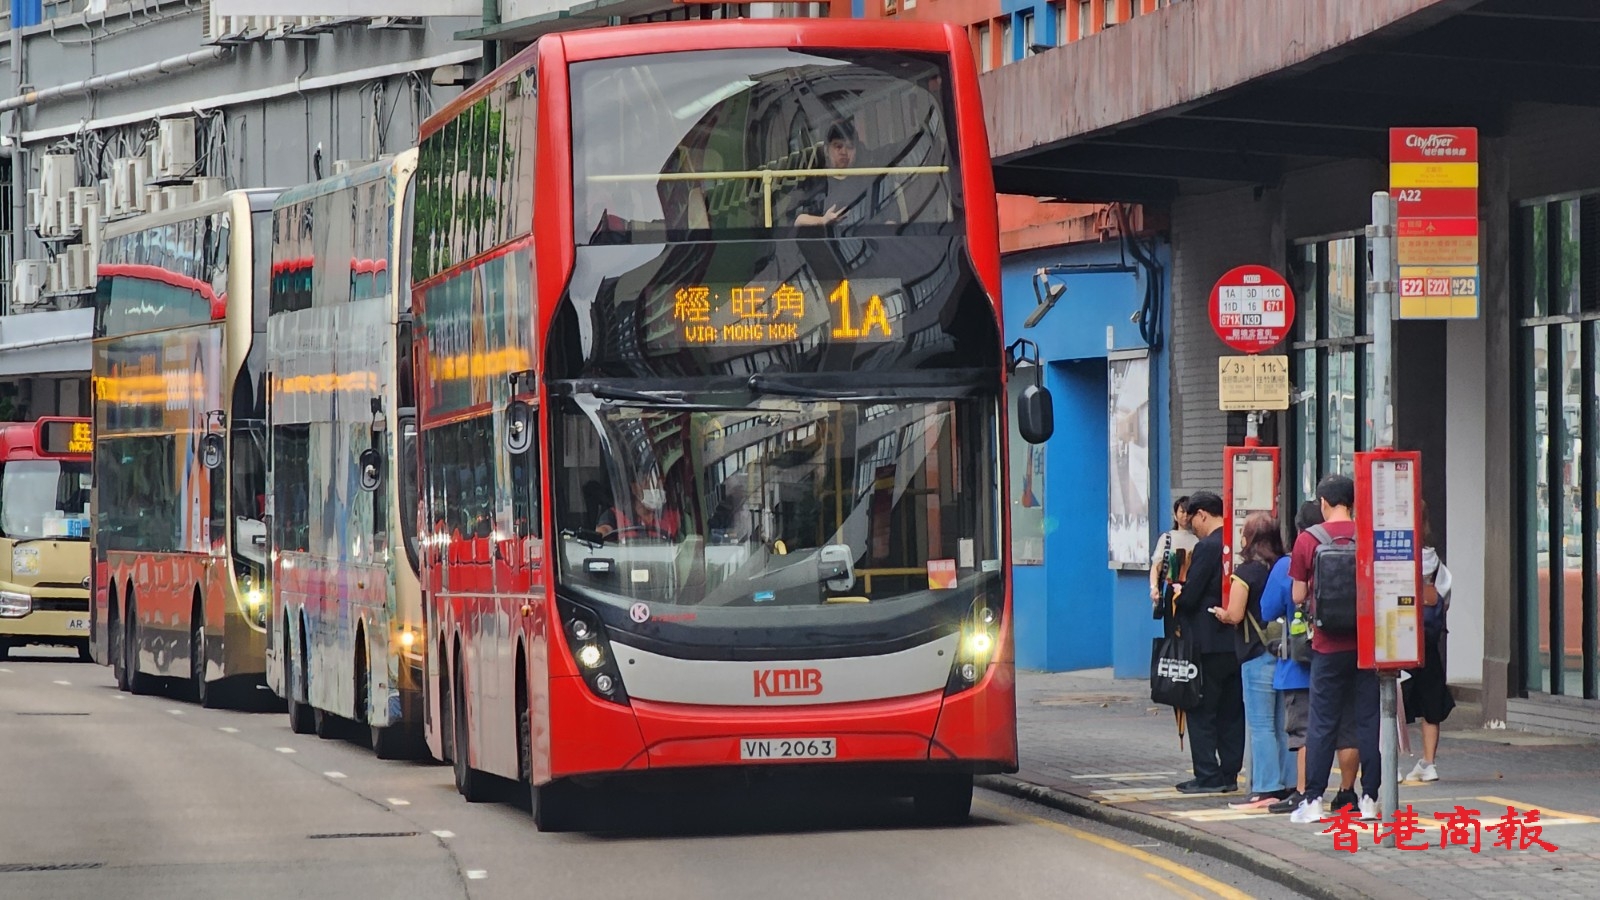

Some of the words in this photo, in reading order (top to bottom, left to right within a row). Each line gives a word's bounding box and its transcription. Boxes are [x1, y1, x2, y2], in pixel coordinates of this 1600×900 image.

[1405, 134, 1455, 151] Cityflyer
[1399, 190, 1421, 201] A22
[1402, 280, 1423, 295] E22
[1427, 280, 1449, 295] E22X
[1226, 289, 1236, 298] 1A
[1246, 289, 1257, 298] 3D
[1266, 289, 1281, 298] 11C
[731, 283, 805, 319] 旺角
[1224, 302, 1238, 311] 11D
[1248, 302, 1257, 311] 16
[1266, 302, 1280, 311] 671
[829, 278, 892, 338] 1A
[1221, 314, 1240, 325] 671X
[1244, 314, 1261, 325] N3D
[685, 326, 718, 343] VIA:
[724, 324, 763, 341] MONG
[768, 323, 798, 341] KOK
[70, 619, 83, 628] AR
[753, 668, 823, 697] KMB
[745, 741, 770, 757] VN
[780, 740, 832, 756] 2063
